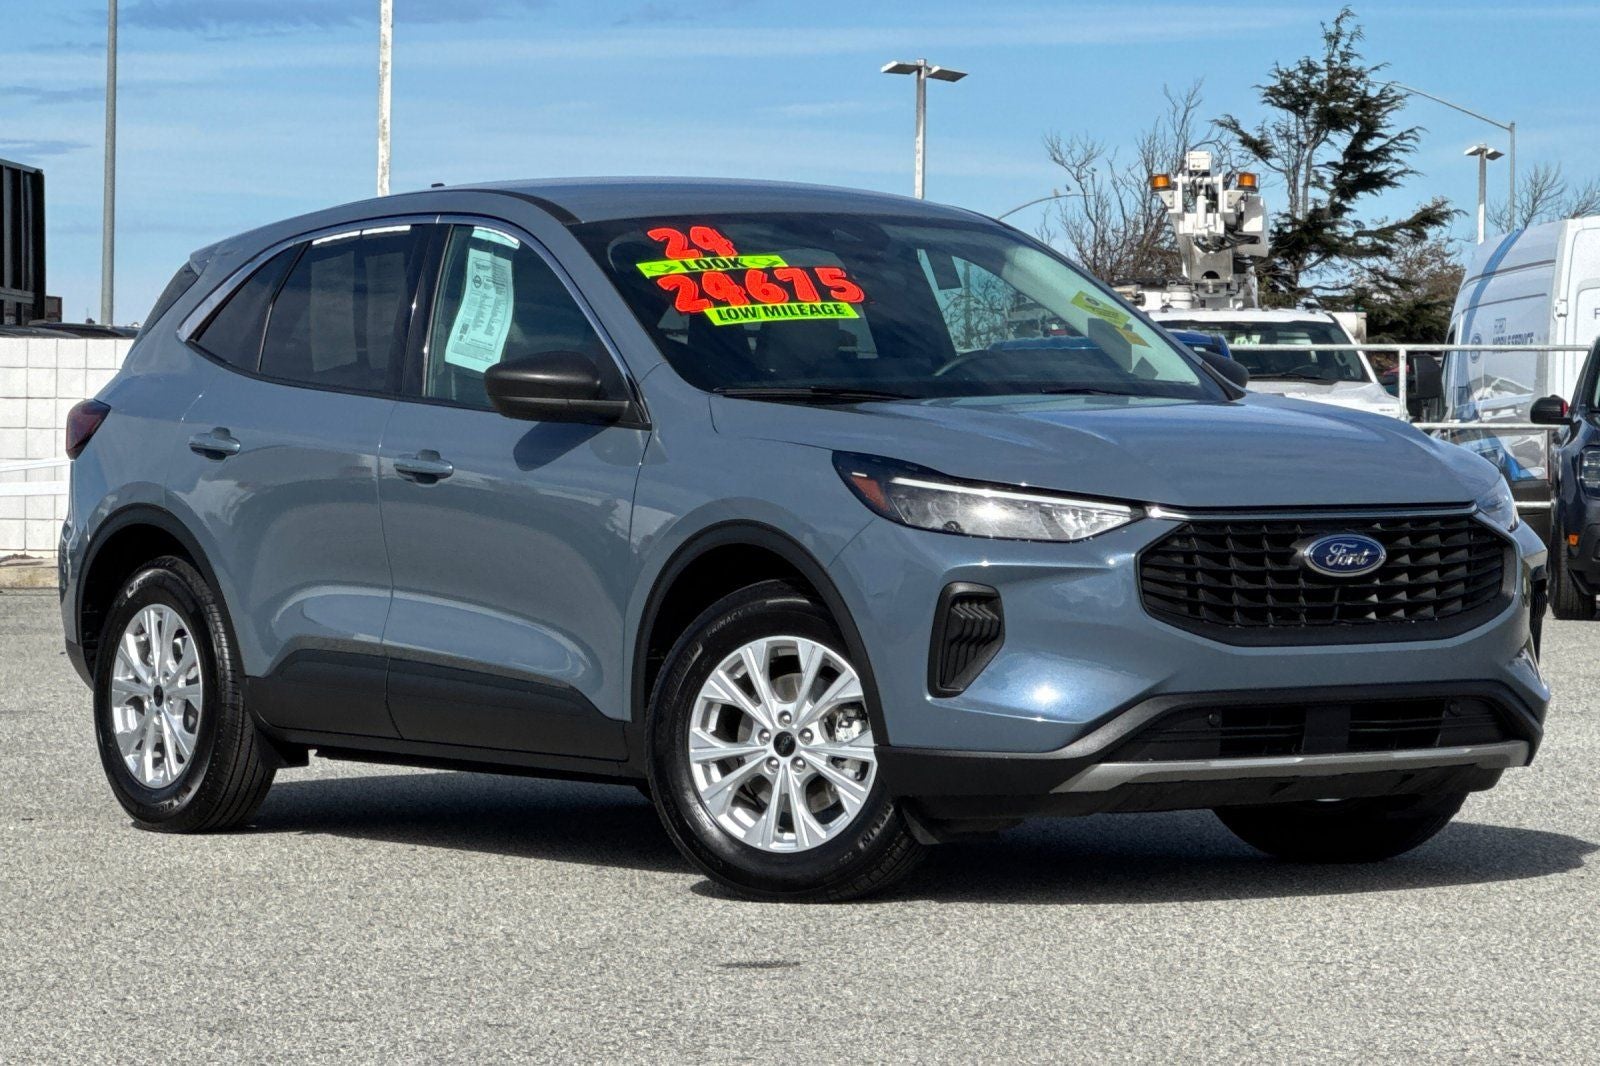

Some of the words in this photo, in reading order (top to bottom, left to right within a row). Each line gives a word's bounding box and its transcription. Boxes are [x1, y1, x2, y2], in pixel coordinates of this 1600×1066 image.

[647, 226, 738, 259] 24
[680, 257, 747, 271] LOOK
[656, 266, 865, 313] 24675
[716, 306, 757, 321] LOW
[761, 303, 845, 317] MILEAGE
[1325, 542, 1369, 567] Ford
